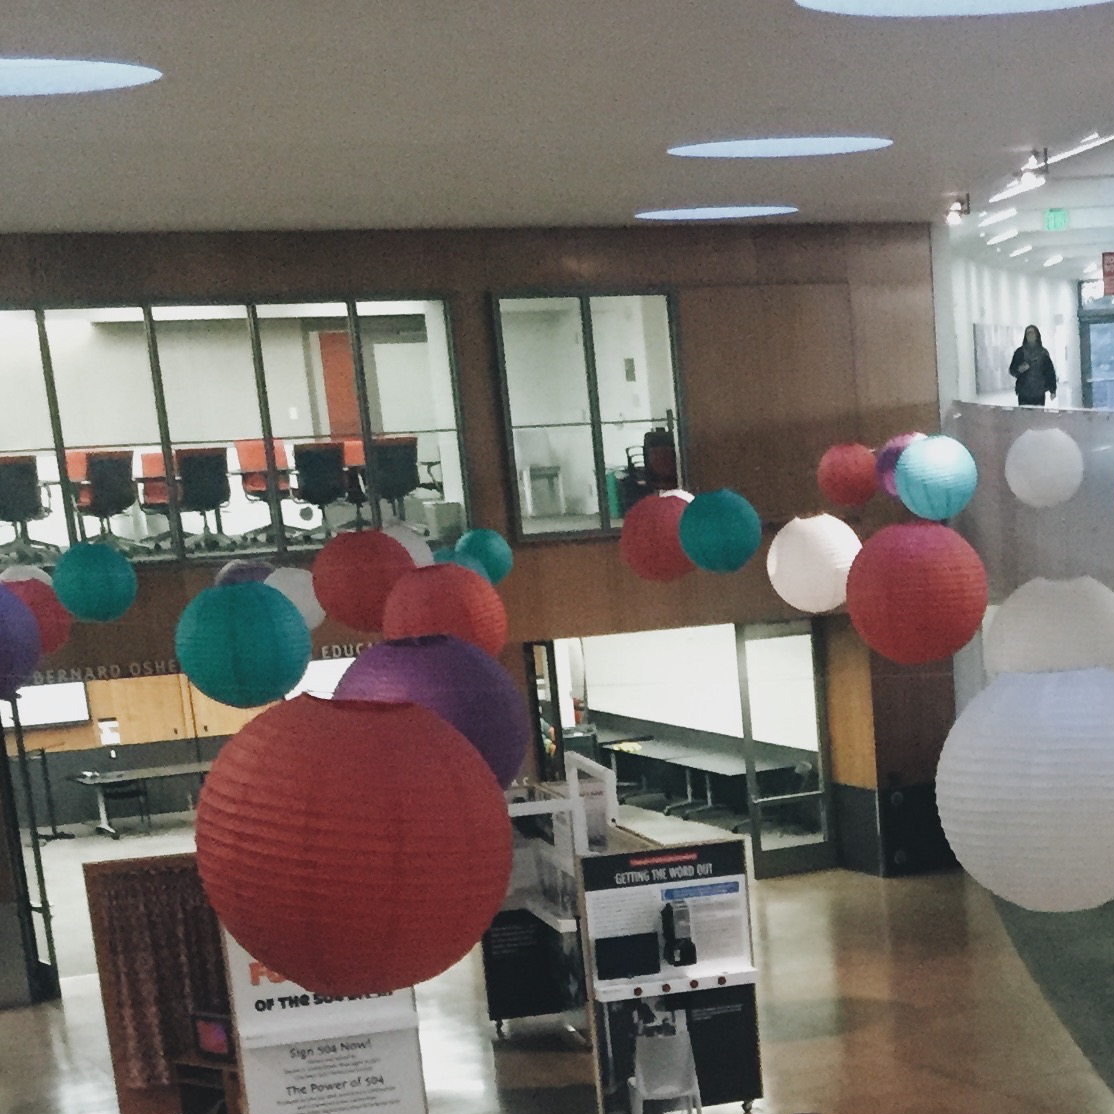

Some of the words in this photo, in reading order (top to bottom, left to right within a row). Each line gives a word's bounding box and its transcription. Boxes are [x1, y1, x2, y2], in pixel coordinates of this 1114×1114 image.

[33, 664, 120, 686] BERNARD
[614, 869, 650, 885] GETTING
[651, 867, 667, 880] THE
[669, 864, 695, 878] WORD
[696, 862, 713, 876] OUT
[254, 998, 275, 1012] OF
[285, 1085, 308, 1096] The
[310, 1079, 347, 1093] Power
[349, 1075, 361, 1088] of
